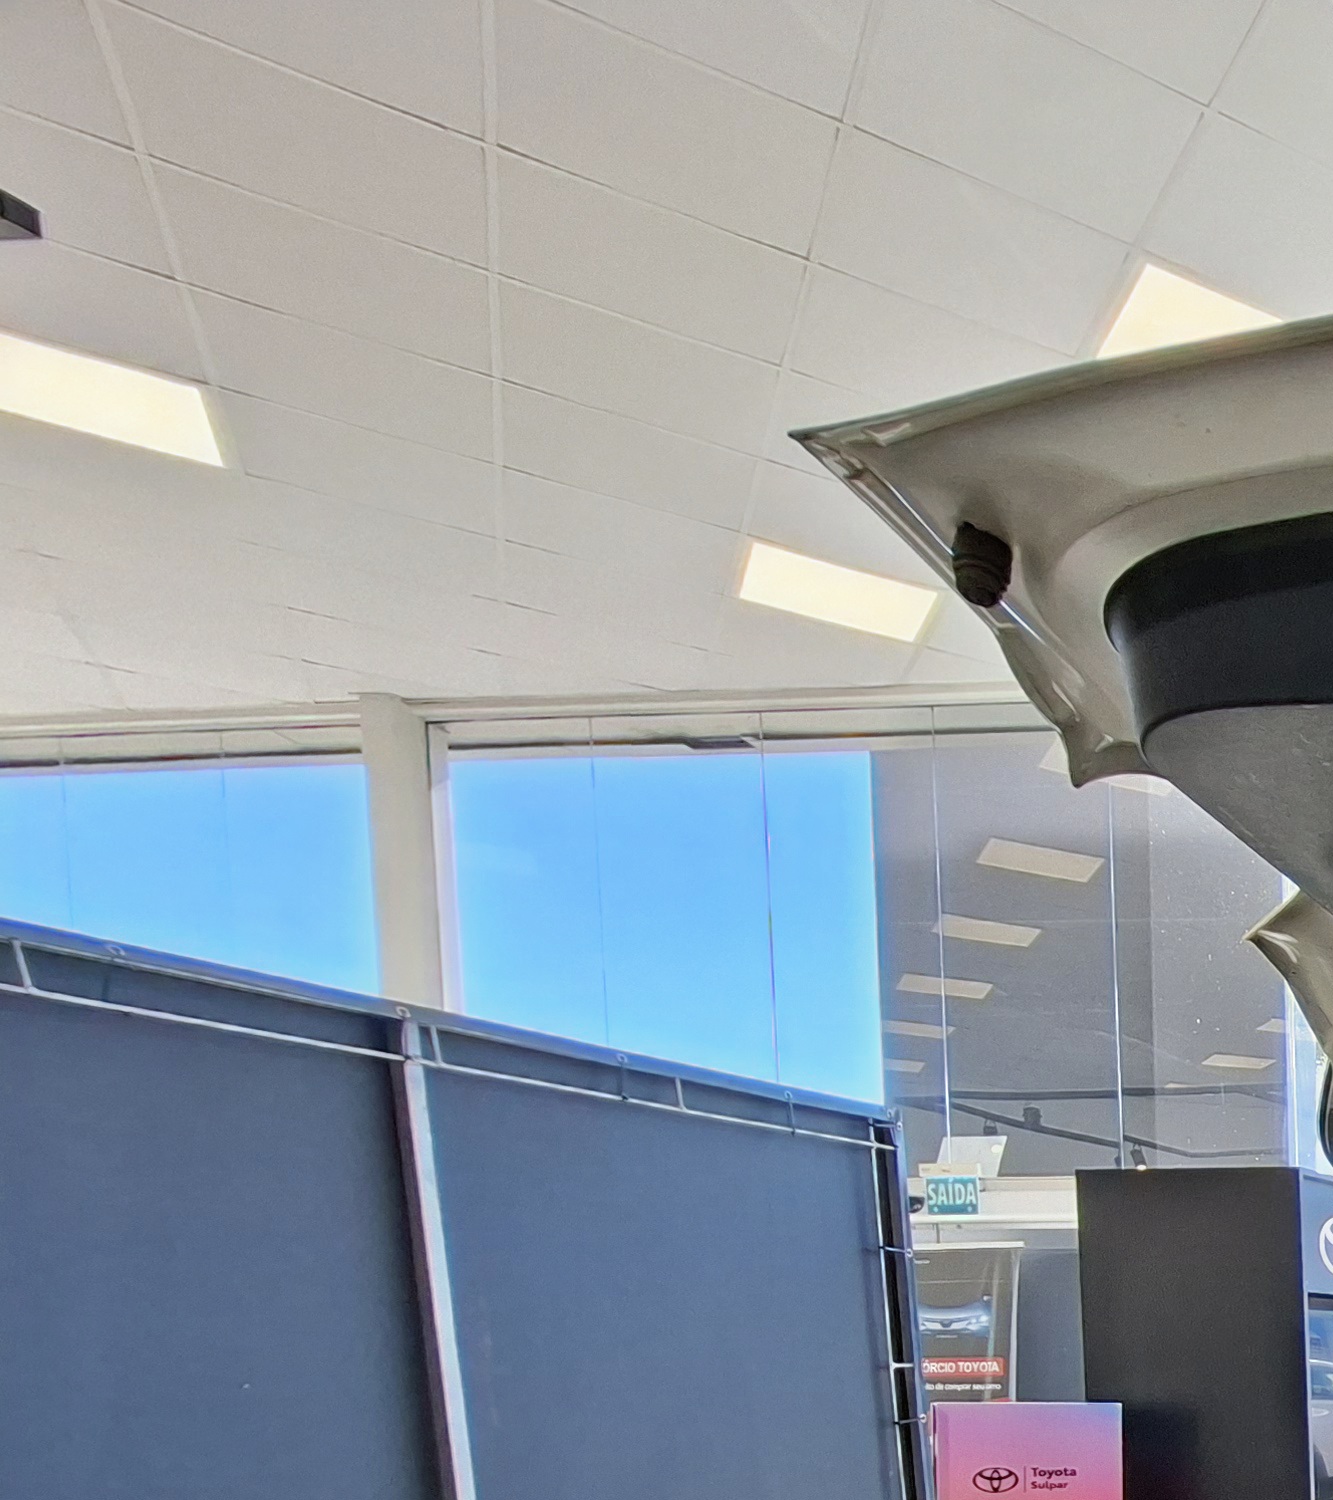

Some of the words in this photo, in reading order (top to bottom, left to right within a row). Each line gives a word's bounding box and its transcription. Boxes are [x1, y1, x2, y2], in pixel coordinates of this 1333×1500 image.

[928, 1178, 976, 1206] SAÍDA
[922, 1360, 956, 1373] ÓRCIO
[957, 1361, 1000, 1373] TOYOTA
[1031, 1467, 1077, 1479] Toyota
[1031, 1481, 1068, 1491] Sulpar
